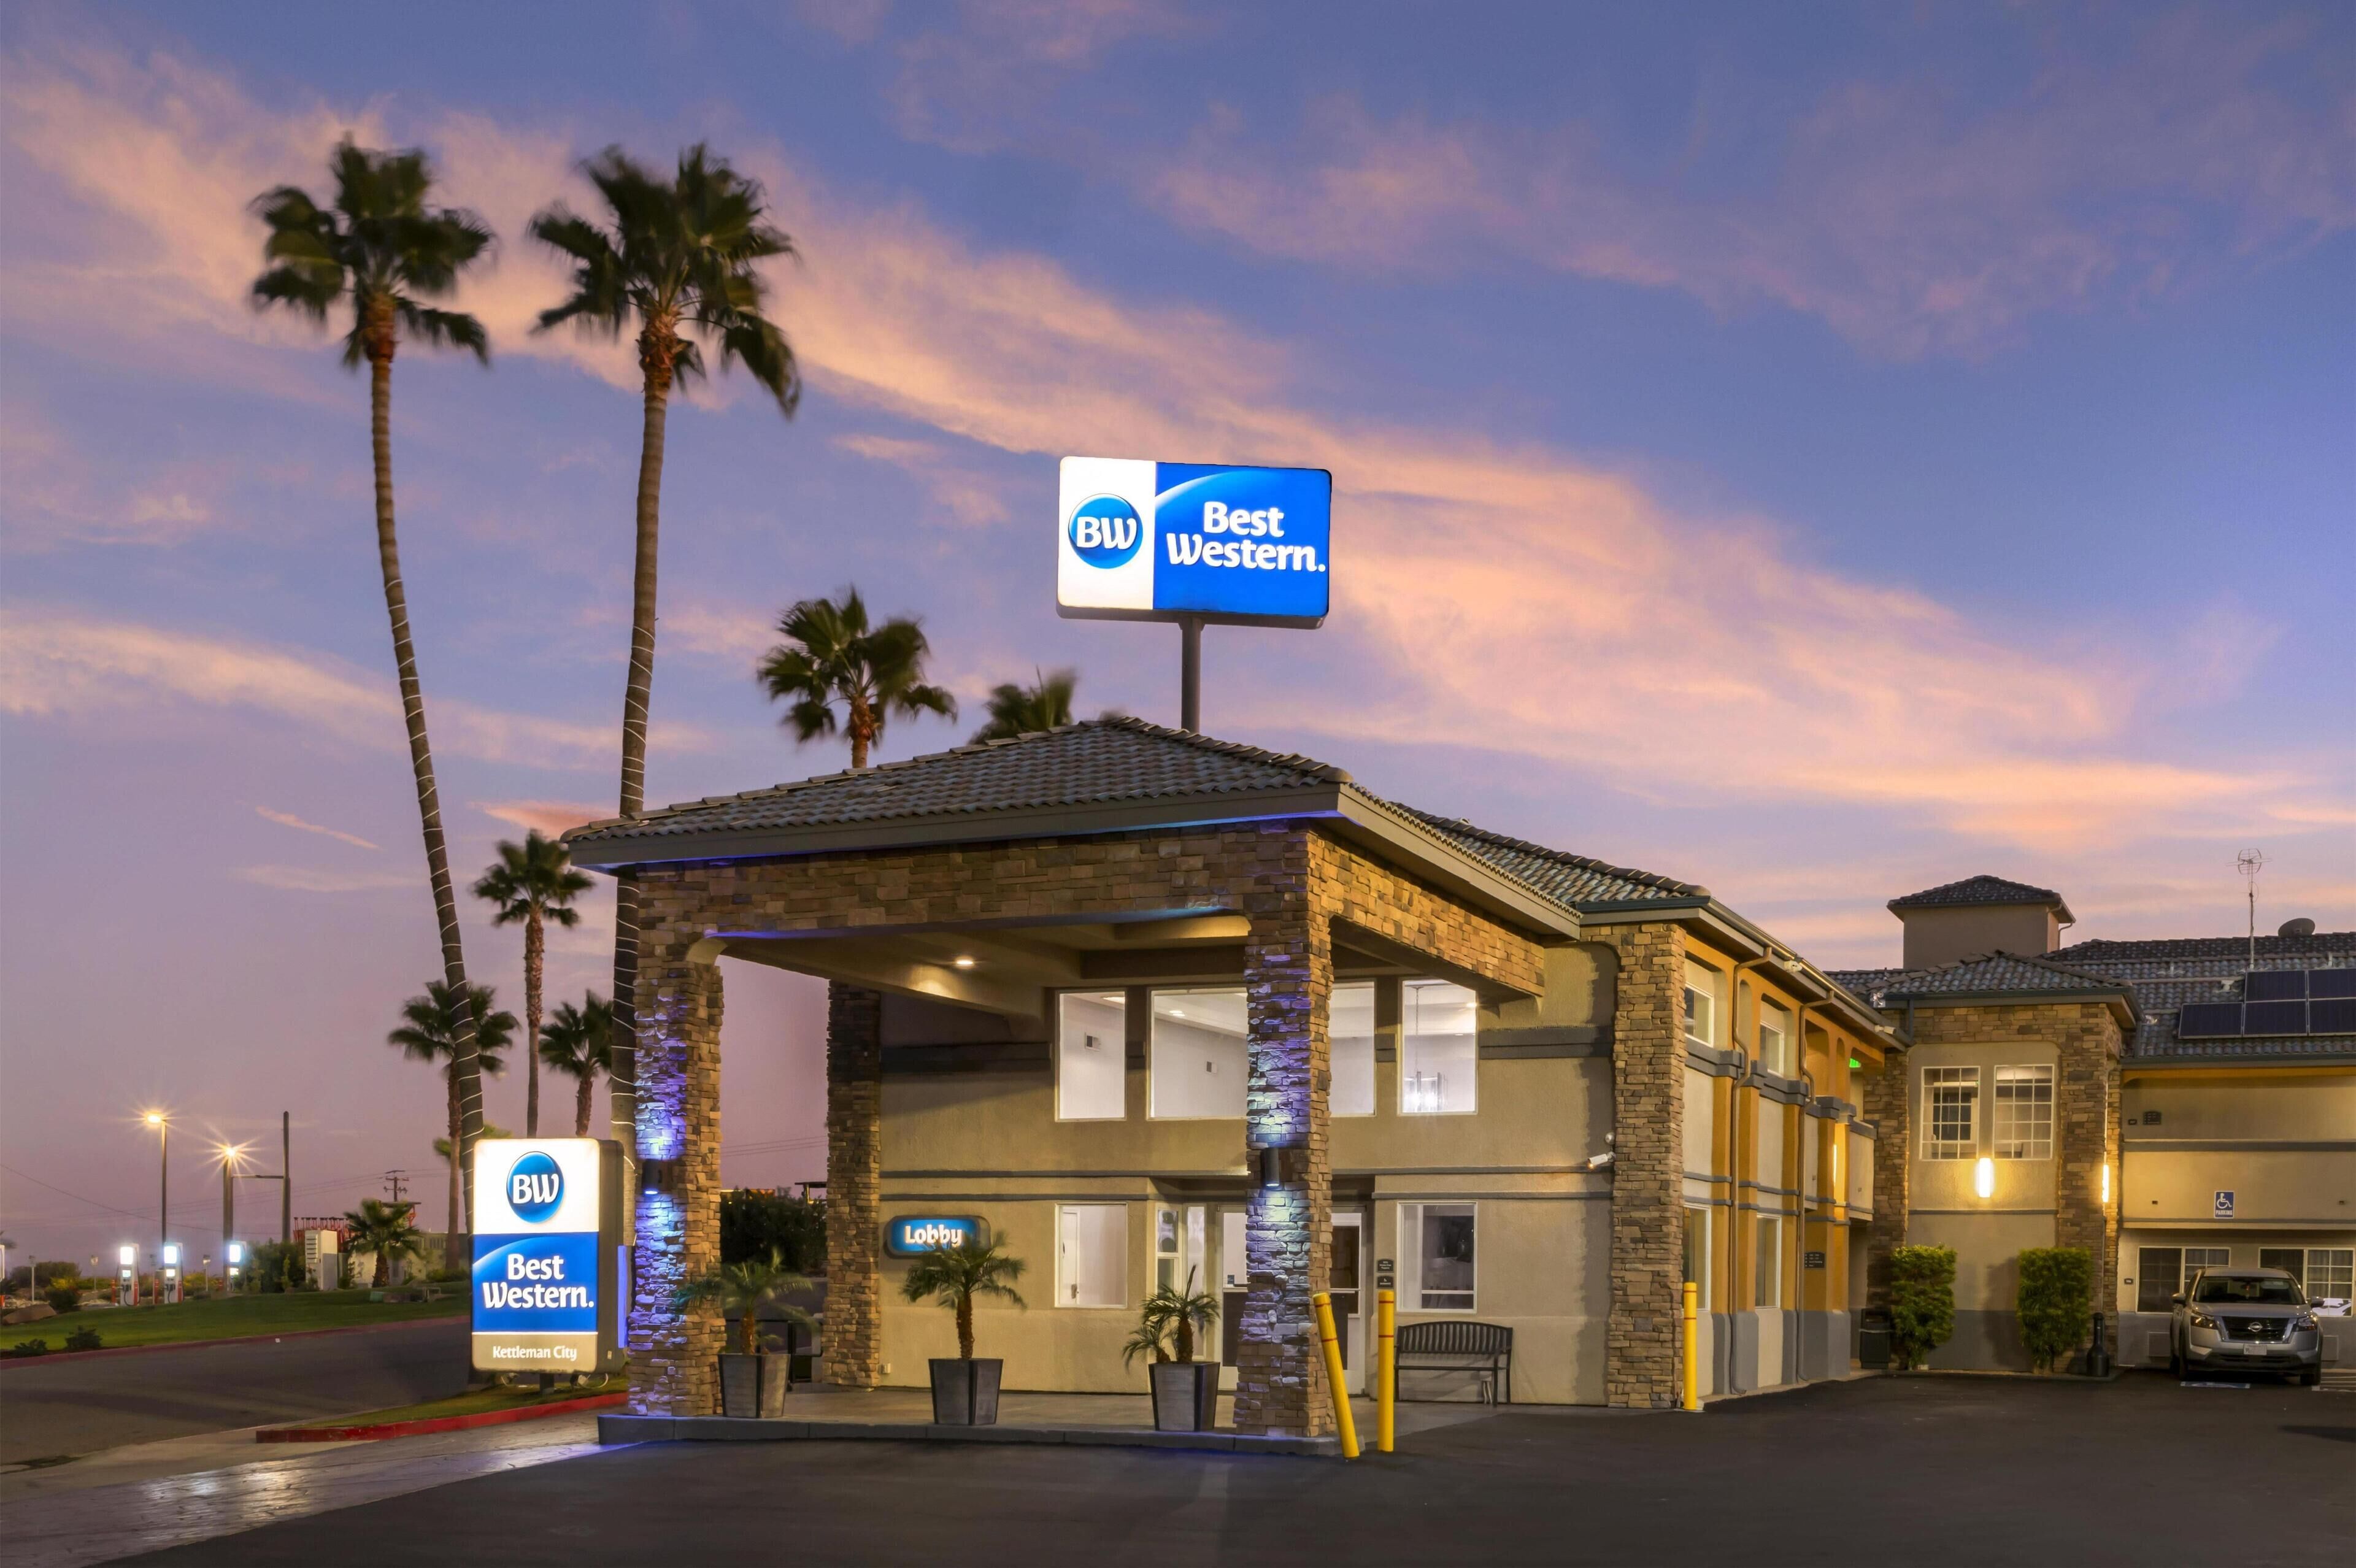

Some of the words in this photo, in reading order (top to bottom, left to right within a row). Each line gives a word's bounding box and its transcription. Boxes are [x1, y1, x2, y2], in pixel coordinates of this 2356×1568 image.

[1077, 517, 1136, 549] BW
[1204, 501, 1284, 537] Best
[512, 1174, 559, 1204] BW
[905, 1224, 963, 1247] Lobby
[507, 1254, 564, 1280] Best
[493, 1345, 551, 1359] Kettleman
[553, 1345, 577, 1361] City
